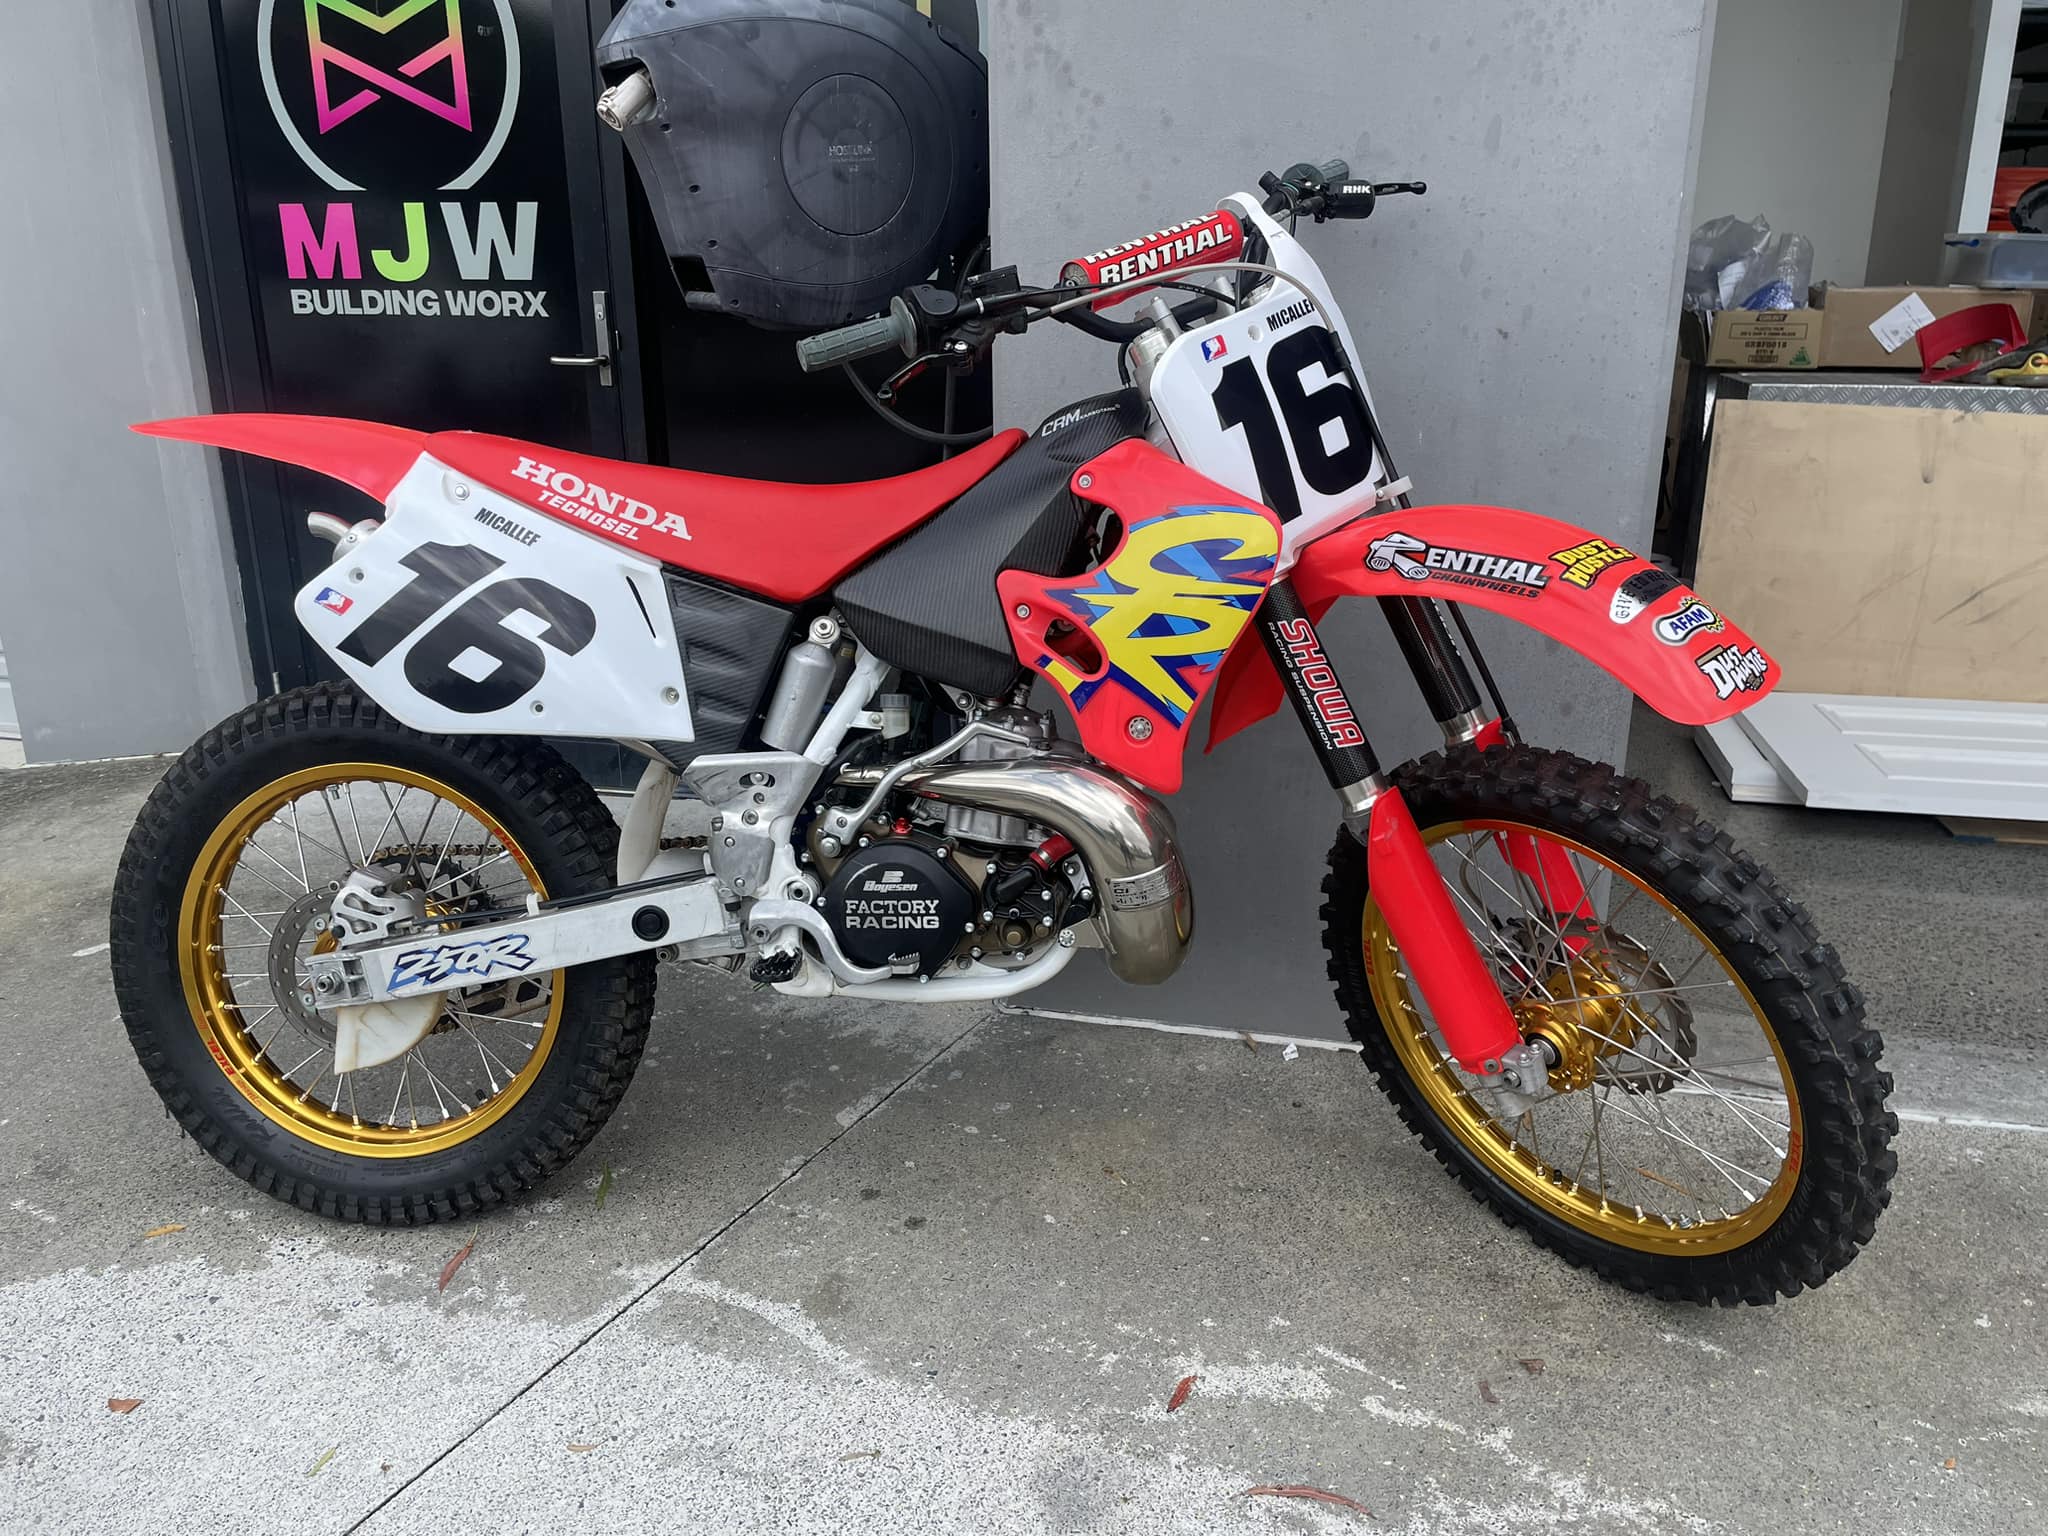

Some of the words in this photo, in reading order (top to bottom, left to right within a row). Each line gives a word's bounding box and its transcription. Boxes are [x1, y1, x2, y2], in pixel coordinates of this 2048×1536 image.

[1343, 185, 1371, 194] RHK
[1099, 223, 1233, 284] RENTHAL
[290, 289, 441, 316] BUILDING
[444, 290, 550, 318] WORX
[1211, 325, 1374, 525] 16
[511, 456, 693, 541] HONDA
[538, 490, 639, 540] TECNOSEL
[474, 507, 541, 547] MICALLEF
[1549, 540, 1608, 566] DUST
[1430, 571, 1540, 599] CHAINWHEELS
[335, 541, 597, 714] 16
[1668, 607, 1710, 636] AFAM
[1267, 622, 1294, 669] RACING
[1291, 671, 1333, 750] SUSPENSION
[1277, 618, 1365, 748] SHOWA
[845, 899, 940, 914] FACTORY
[845, 916, 940, 929] RACING
[394, 934, 536, 988] 250R
